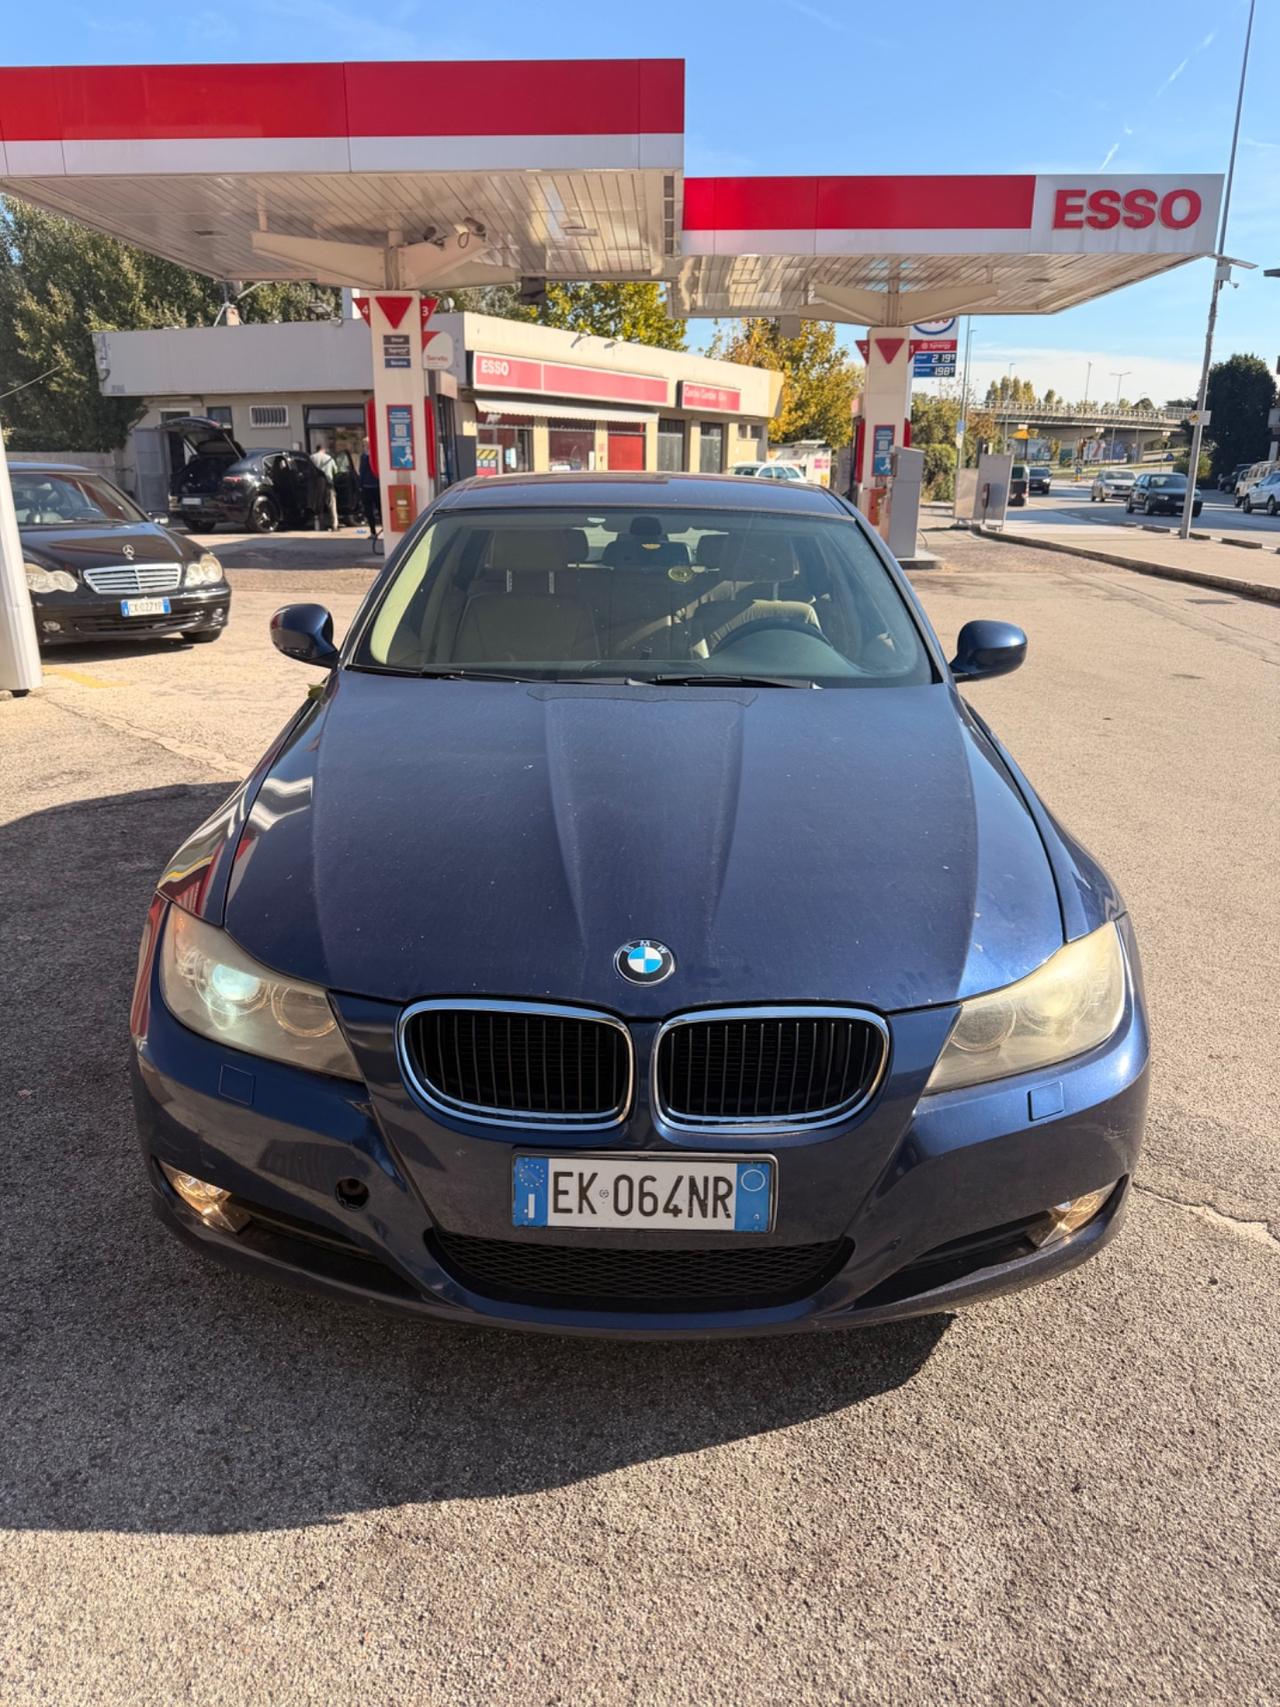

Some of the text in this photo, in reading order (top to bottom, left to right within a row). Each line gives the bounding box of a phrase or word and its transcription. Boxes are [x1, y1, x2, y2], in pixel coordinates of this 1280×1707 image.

[1053, 189, 1202, 230] ESSO
[362, 305, 369, 314] 4
[422, 306, 429, 316] 3
[862, 345, 868, 354] 2
[481, 359, 510, 376] ESSO
[624, 940, 669, 954] BMW
[553, 1171, 733, 1219] EK 064NR
